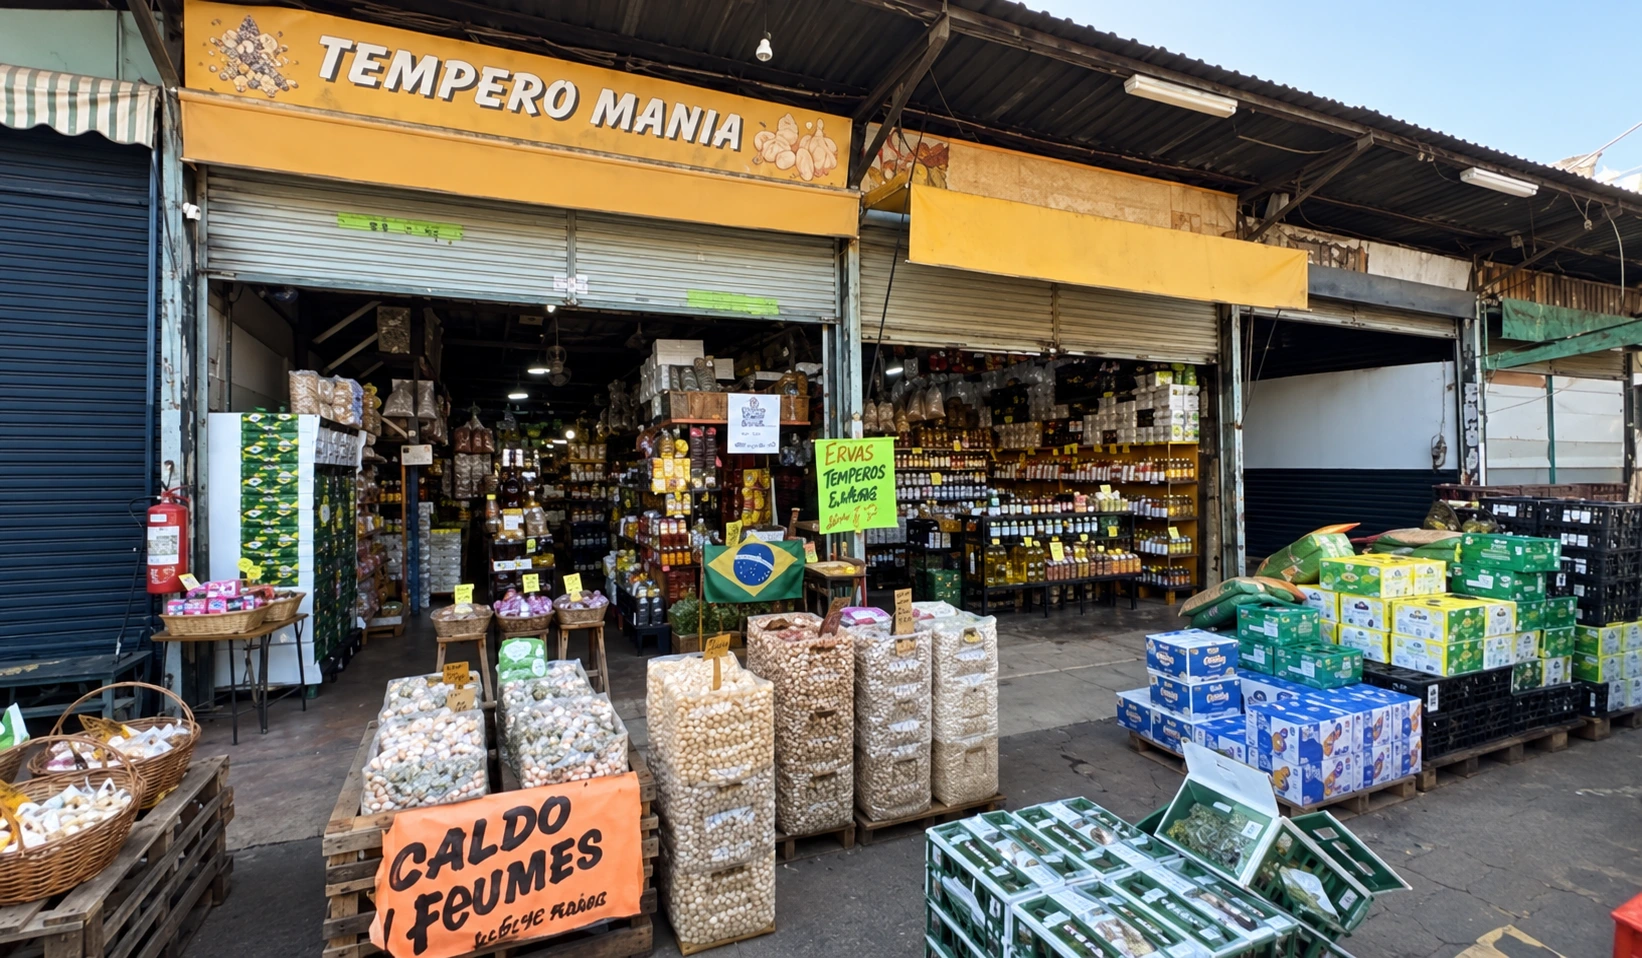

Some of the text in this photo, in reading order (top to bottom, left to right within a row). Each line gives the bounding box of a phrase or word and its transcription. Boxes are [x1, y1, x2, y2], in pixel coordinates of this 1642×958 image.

[318, 35, 743, 151] TEMPERO MANIA
[823, 464, 886, 489] TEMPEROS
[825, 442, 874, 466] ERVAS
[389, 796, 571, 892] CALDO
